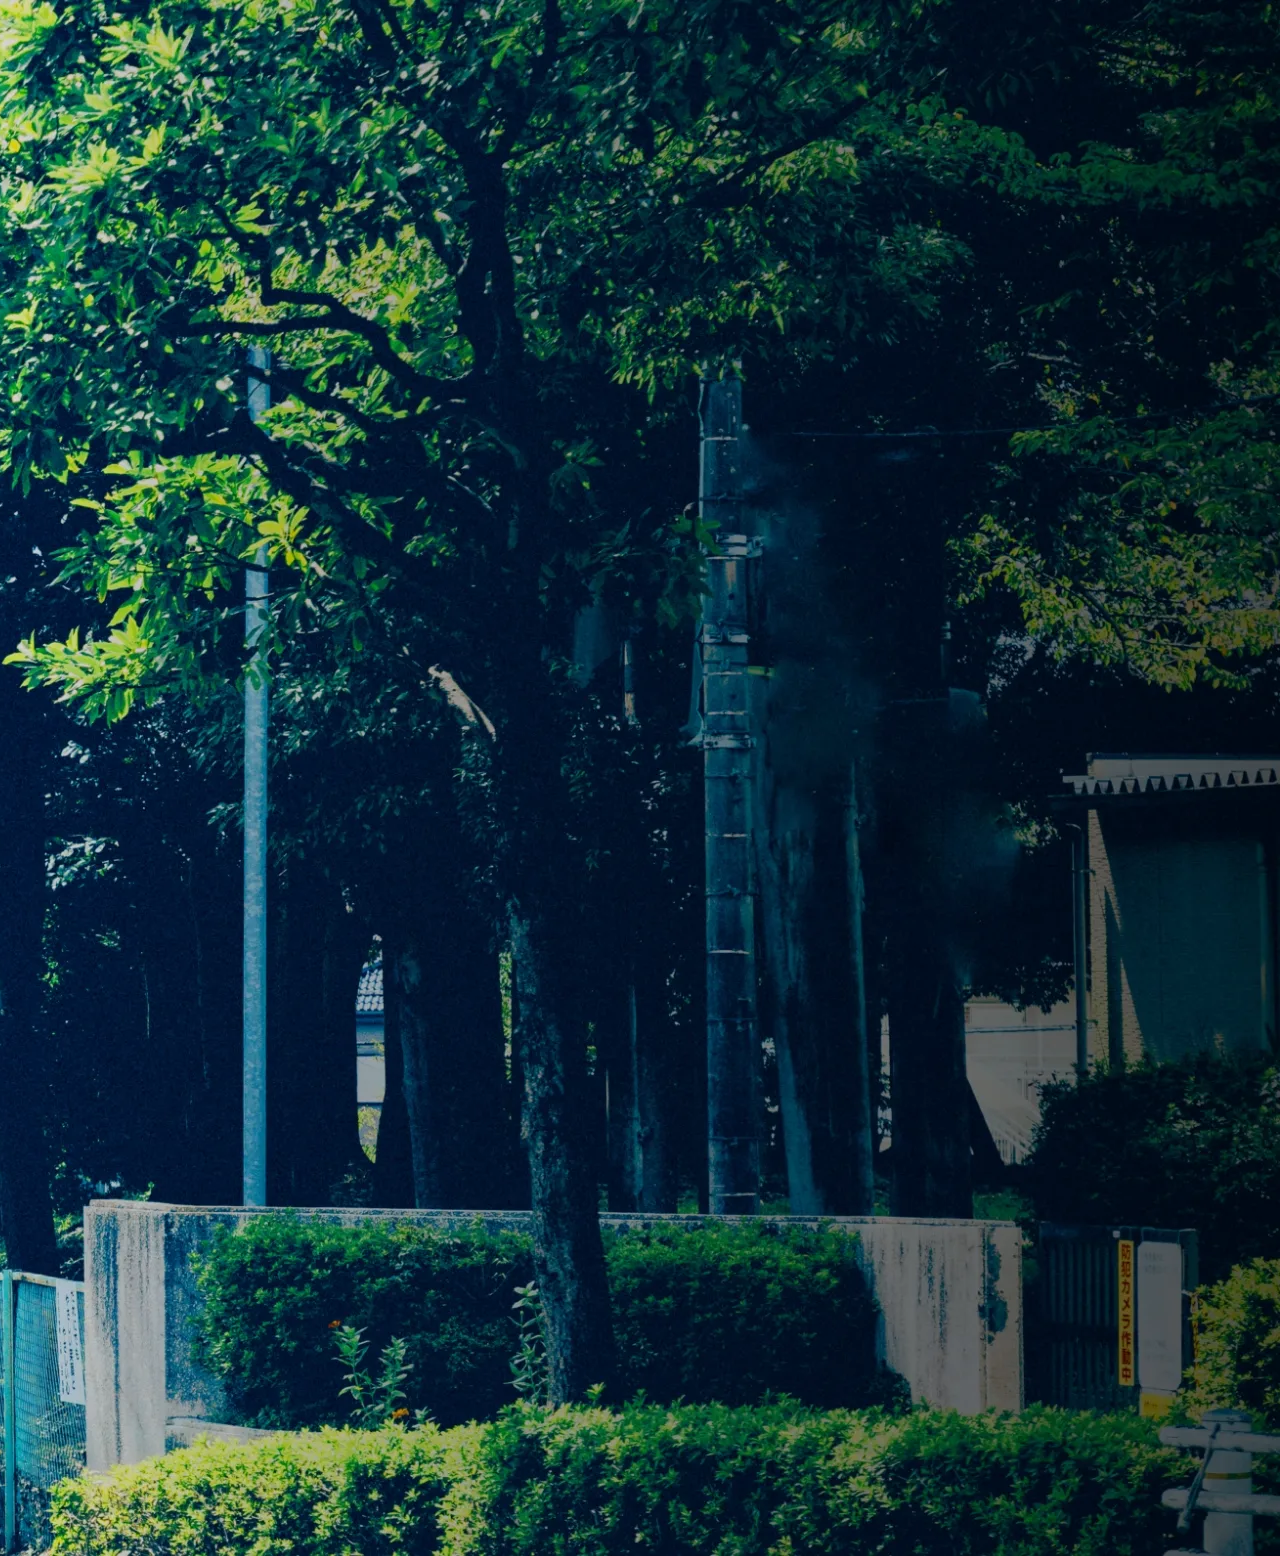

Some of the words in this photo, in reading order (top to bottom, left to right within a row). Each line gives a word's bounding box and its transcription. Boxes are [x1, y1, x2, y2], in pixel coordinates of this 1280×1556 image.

[1121, 1244, 1132, 1382] 防犯カメラ作動中
